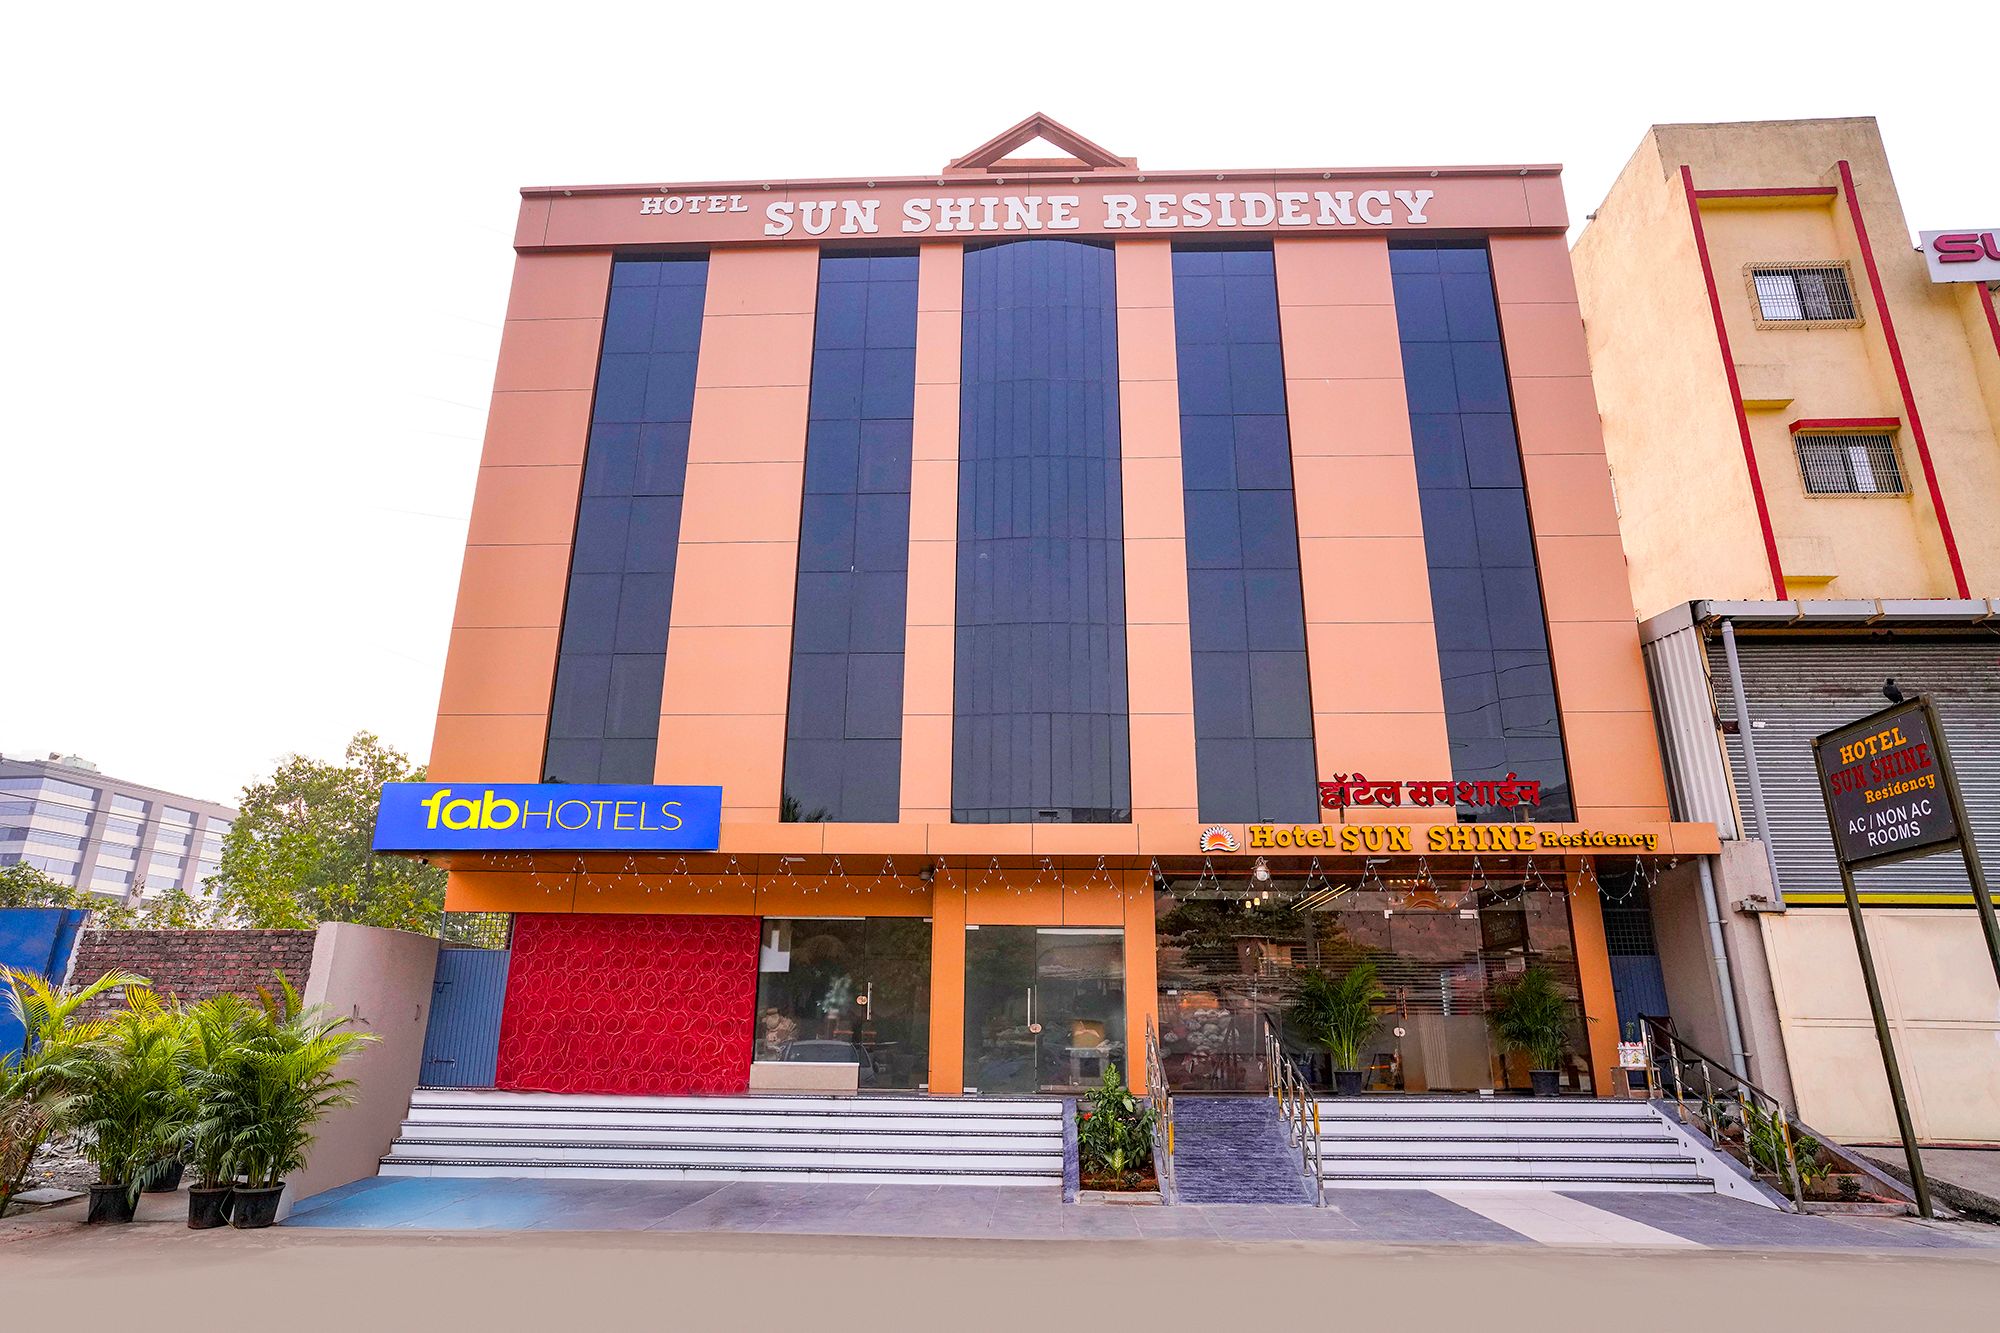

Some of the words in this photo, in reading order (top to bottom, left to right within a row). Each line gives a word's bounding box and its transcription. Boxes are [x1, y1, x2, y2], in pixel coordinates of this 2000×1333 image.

[640, 194, 748, 215] HOTEL
[764, 199, 880, 236] SUN
[902, 196, 1080, 233] SHINE
[1103, 189, 1434, 230] RESIDENCY
[1840, 728, 1907, 764] HOTEL
[1830, 764, 1868, 796] SUN
[1870, 743, 1932, 784] SHINE
[1319, 772, 1402, 809] हॉटेल
[1864, 773, 1936, 804] Residency
[420, 789, 683, 831] fabHOTELS
[1849, 816, 1867, 835] AC
[1876, 806, 1908, 829] NON
[1911, 799, 1932, 819] AC
[1250, 826, 1337, 848] Hotel
[1341, 825, 1413, 851] SUN
[1428, 825, 1538, 852] SHINE
[1541, 830, 1658, 850] Residency
[1867, 820, 1921, 847] ROOMS
